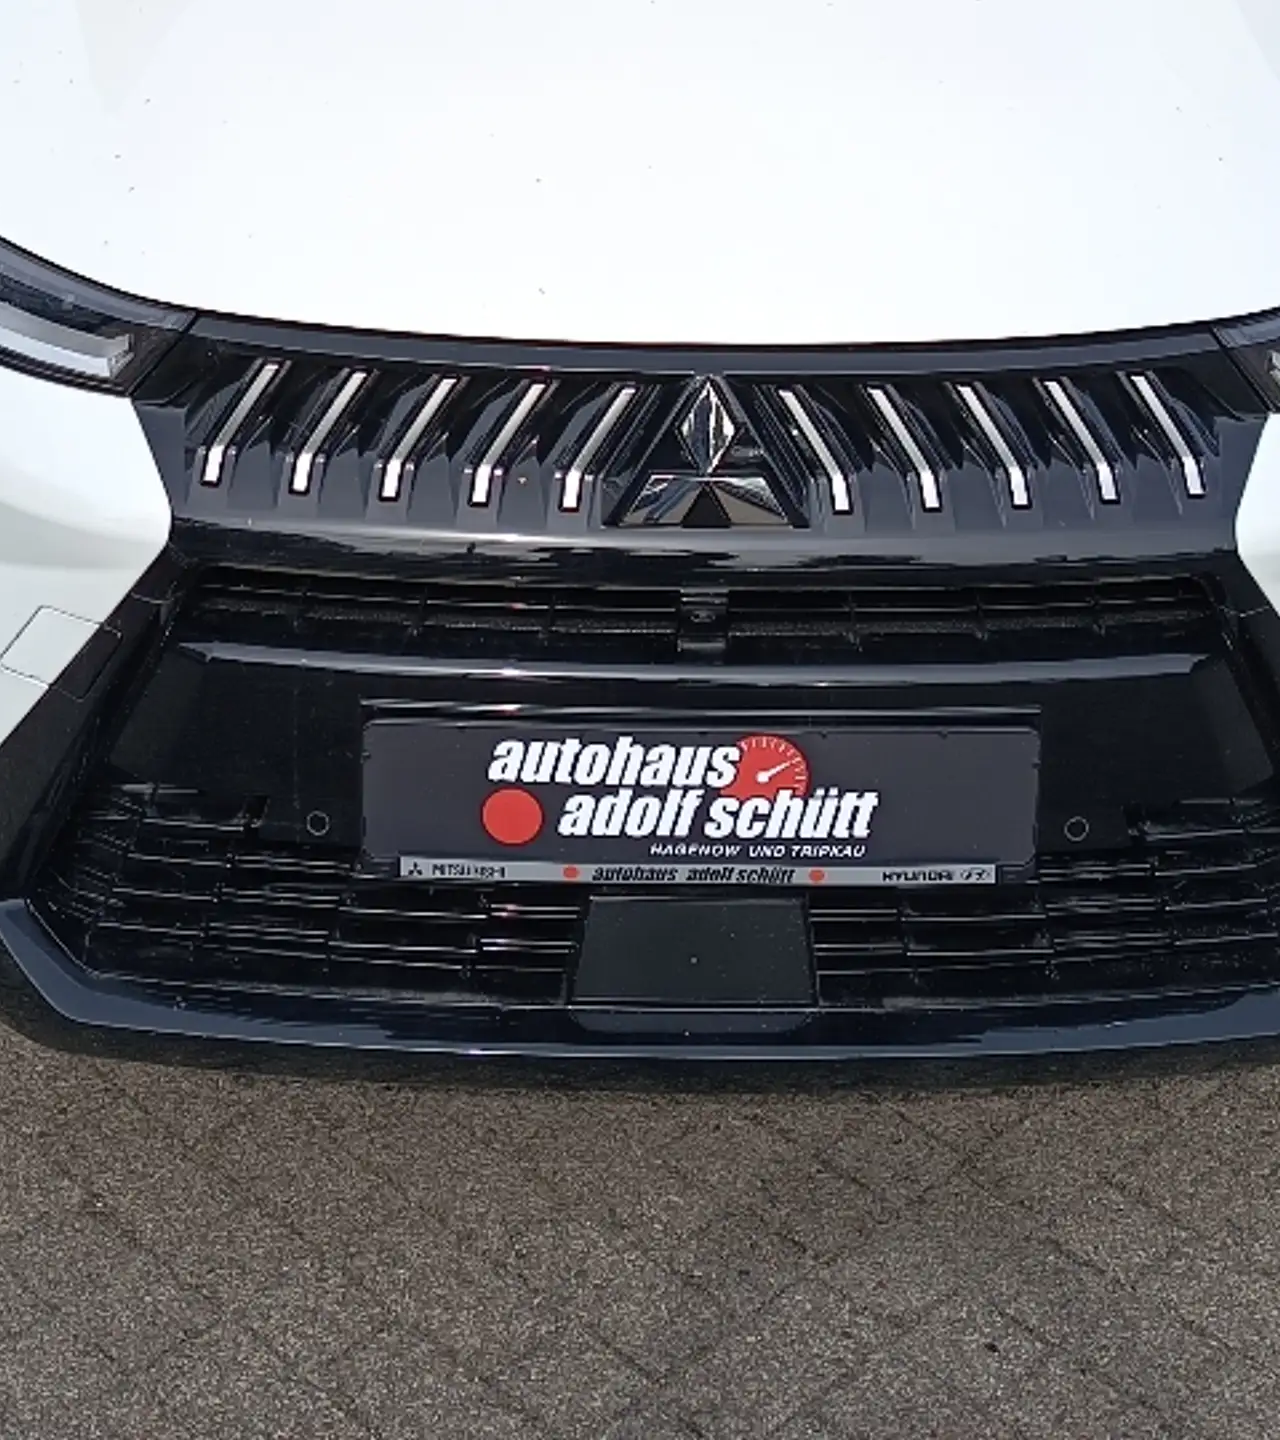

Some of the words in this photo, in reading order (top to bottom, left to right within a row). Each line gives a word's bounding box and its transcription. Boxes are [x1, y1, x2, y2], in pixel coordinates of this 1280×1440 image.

[487, 735, 743, 787] autohaus
[557, 787, 706, 838] adolf
[704, 788, 879, 839] schütt
[649, 843, 742, 857] HAGENOW
[748, 845, 786, 858] UND
[791, 845, 868, 859] TRIPKAU
[591, 865, 679, 882] autohaus
[685, 866, 735, 882] adolf
[734, 867, 796, 883] schütt
